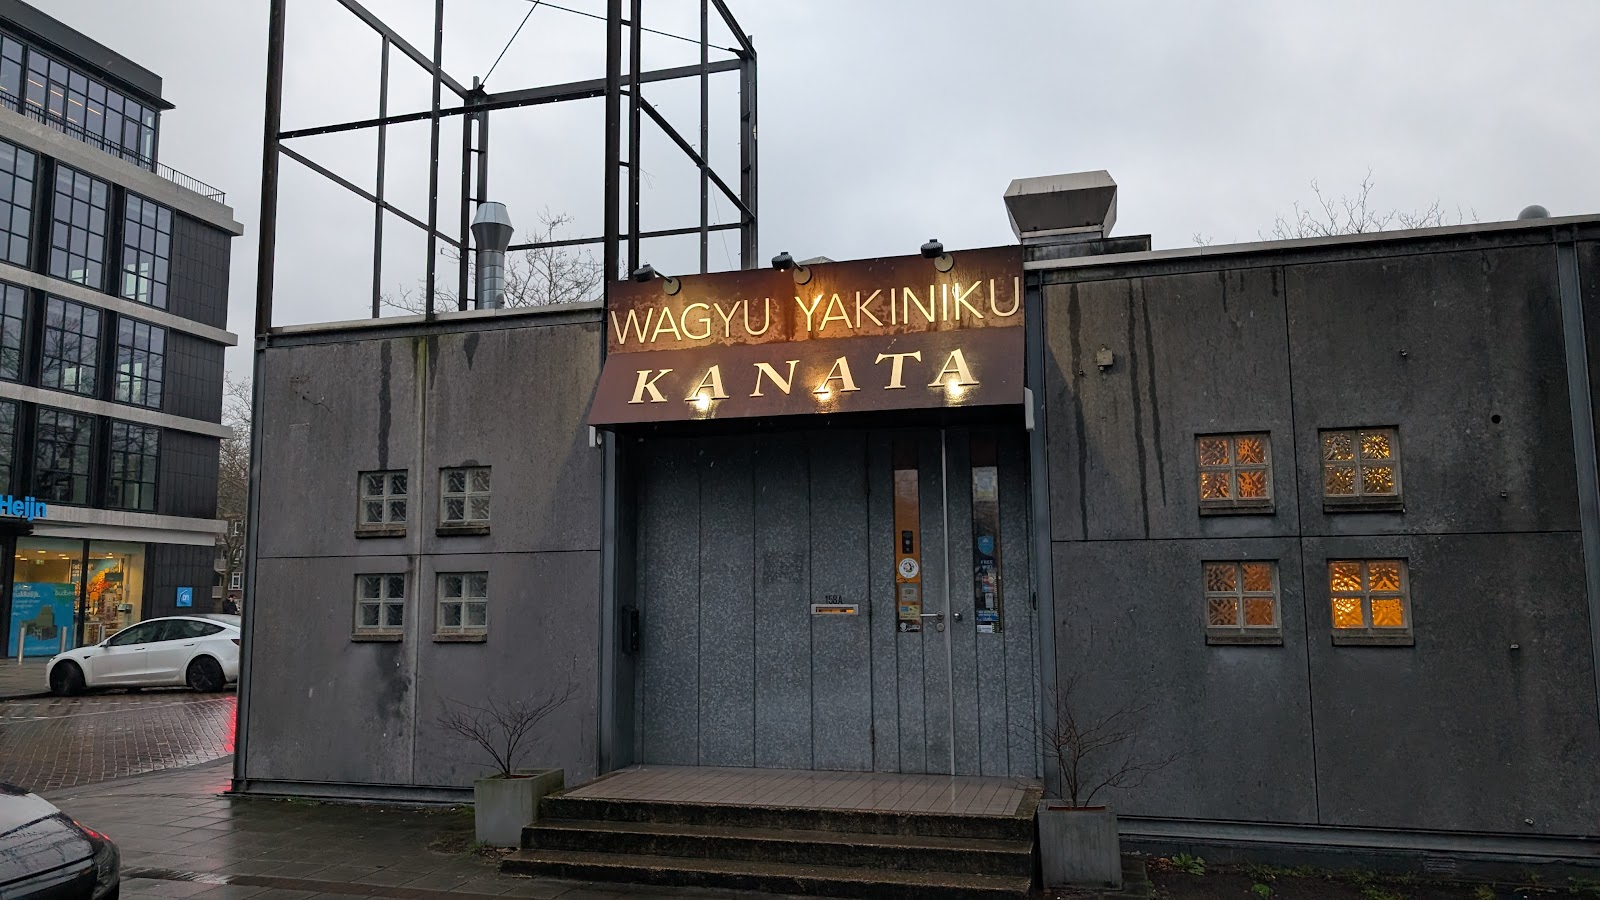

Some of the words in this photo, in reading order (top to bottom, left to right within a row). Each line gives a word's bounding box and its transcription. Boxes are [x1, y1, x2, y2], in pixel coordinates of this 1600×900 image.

[610, 297, 771, 346] WAGYU
[795, 276, 1021, 333] YAKINIKU
[628, 348, 980, 405] KANATA
[0, 494, 47, 521] Heijn
[825, 594, 843, 604] 158A
